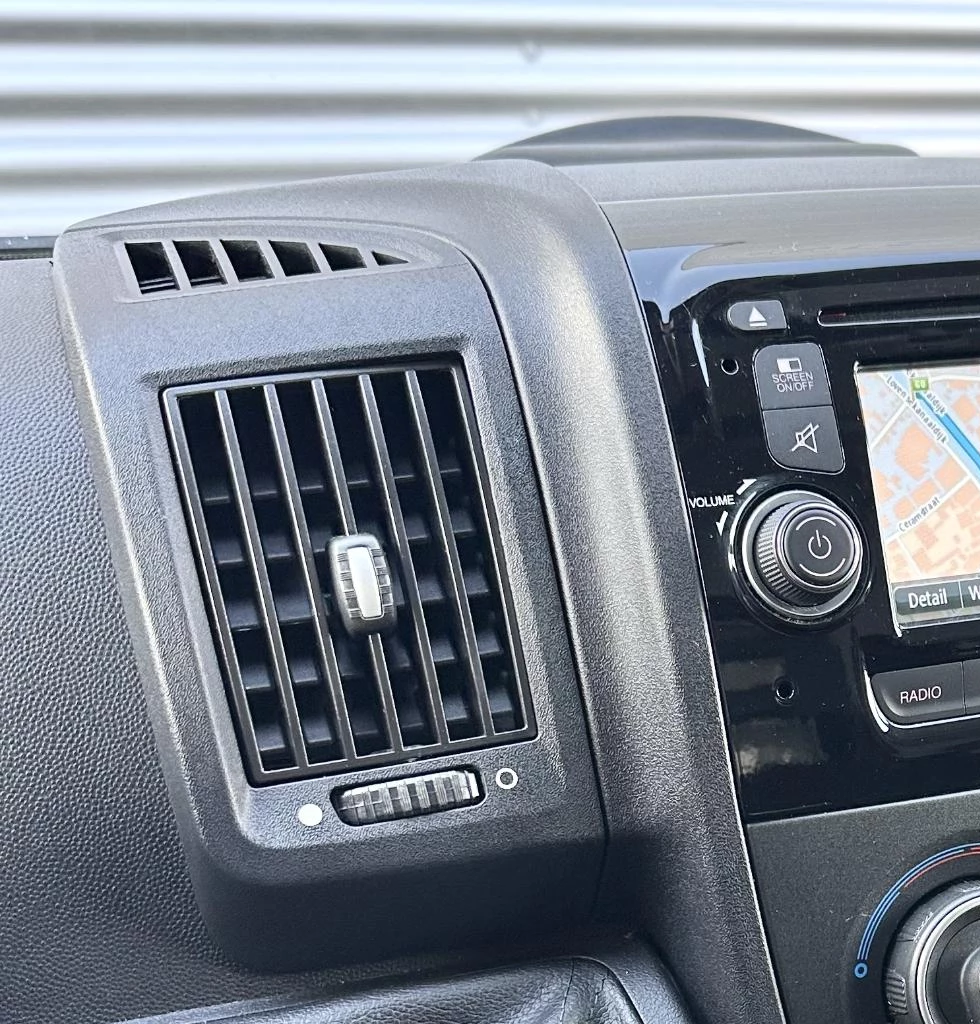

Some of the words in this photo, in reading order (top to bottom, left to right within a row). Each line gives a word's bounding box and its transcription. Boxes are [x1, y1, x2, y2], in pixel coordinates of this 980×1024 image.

[772, 372, 813, 384] SCREEN
[776, 380, 814, 393] ON/OFF
[689, 494, 736, 509] VOLUME
[908, 587, 948, 609] Detail
[900, 685, 942, 704] RADIO
